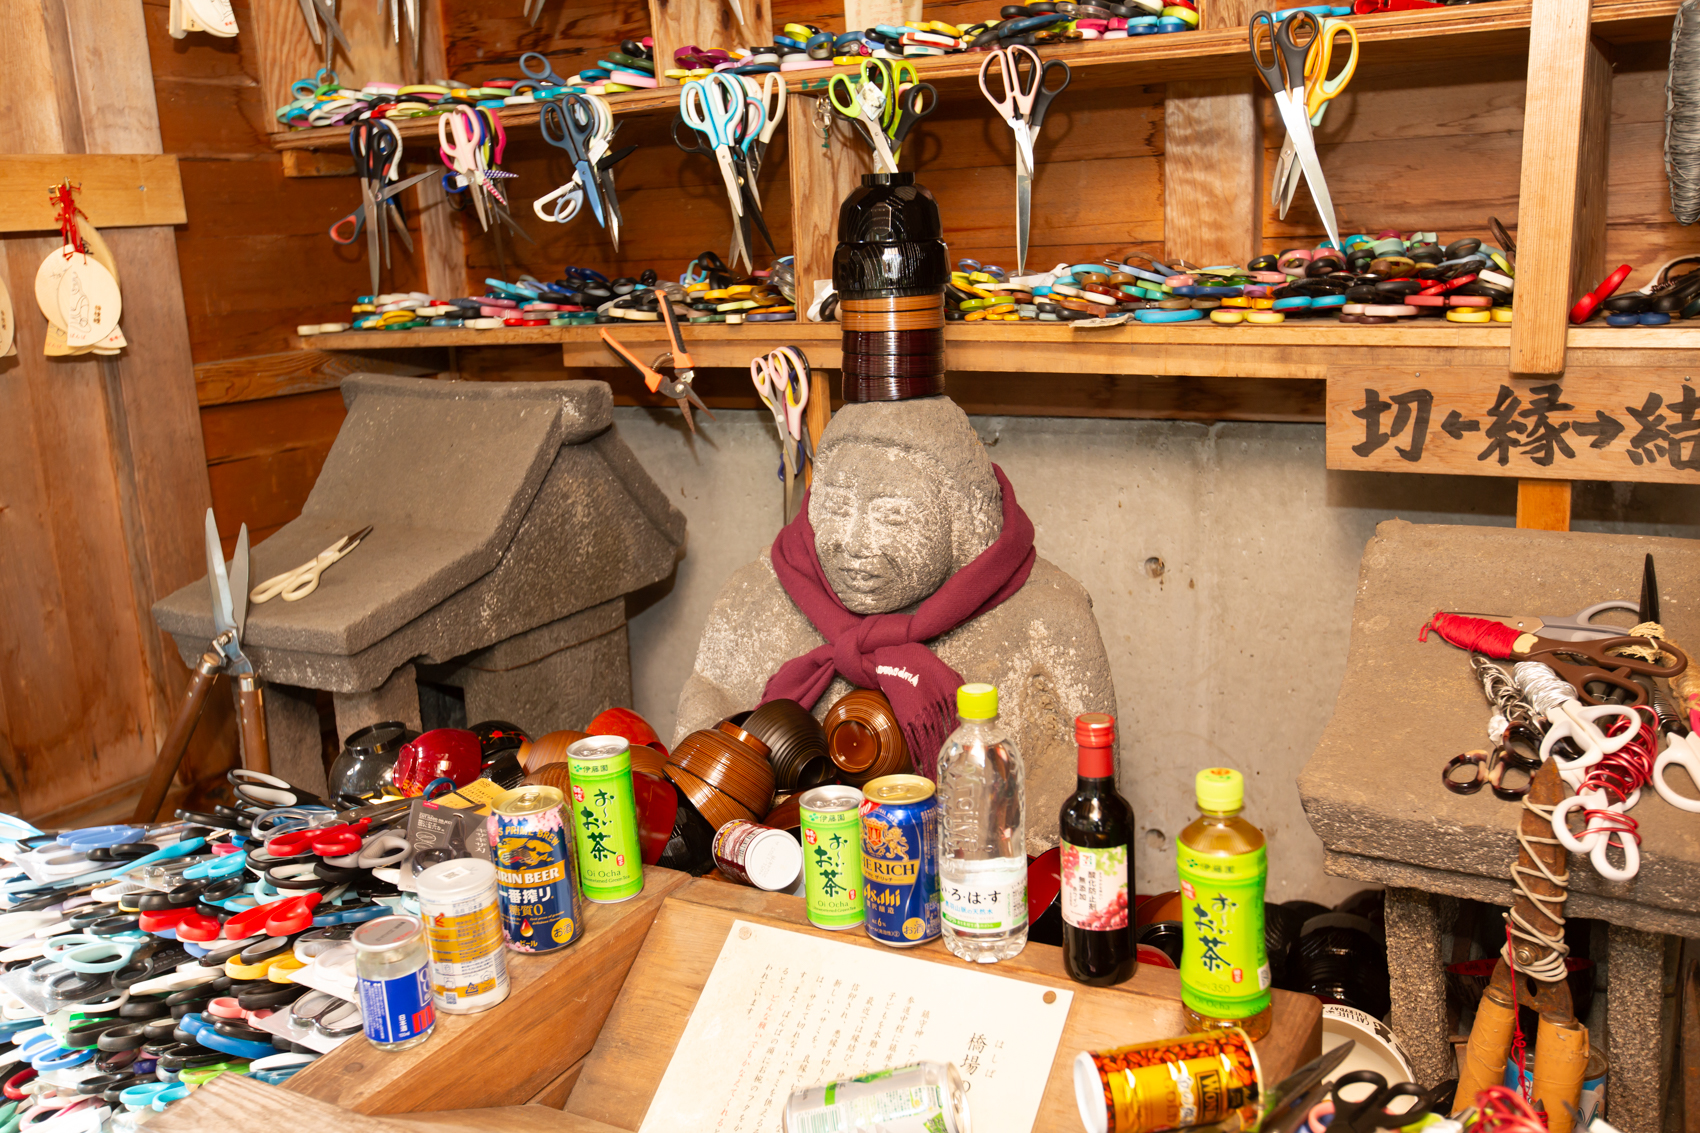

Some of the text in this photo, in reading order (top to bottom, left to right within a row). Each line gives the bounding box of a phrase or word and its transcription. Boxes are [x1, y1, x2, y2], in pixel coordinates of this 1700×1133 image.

[1352, 388, 1433, 462] 切
[1477, 383, 1576, 467] 縁
[1625, 384, 1700, 472] 結
[583, 764, 609, 773] 伊藤園
[820, 813, 845, 822] 伊藤園
[505, 826, 534, 836] PRIME
[537, 829, 560, 847] BREW
[580, 806, 617, 862] お茶
[524, 867, 560, 884] BEER
[587, 869, 596, 877] Oi
[814, 845, 847, 897] お茶
[874, 861, 915, 876] RICH
[499, 886, 551, 904] 一番搾り
[863, 883, 900, 907] Asahi
[1079, 876, 1087, 901] 無添加
[1088, 871, 1097, 911] 酸化防止剤
[828, 900, 849, 908] Ocha
[553, 922, 573, 938] お酒
[904, 923, 925, 935] お酒
[1193, 903, 1233, 971] お茶
[520, 940, 538, 948] ビール
[1329, 1006, 1368, 1020] EVERYDAY
[1356, 1016, 1370, 1026] CAT
